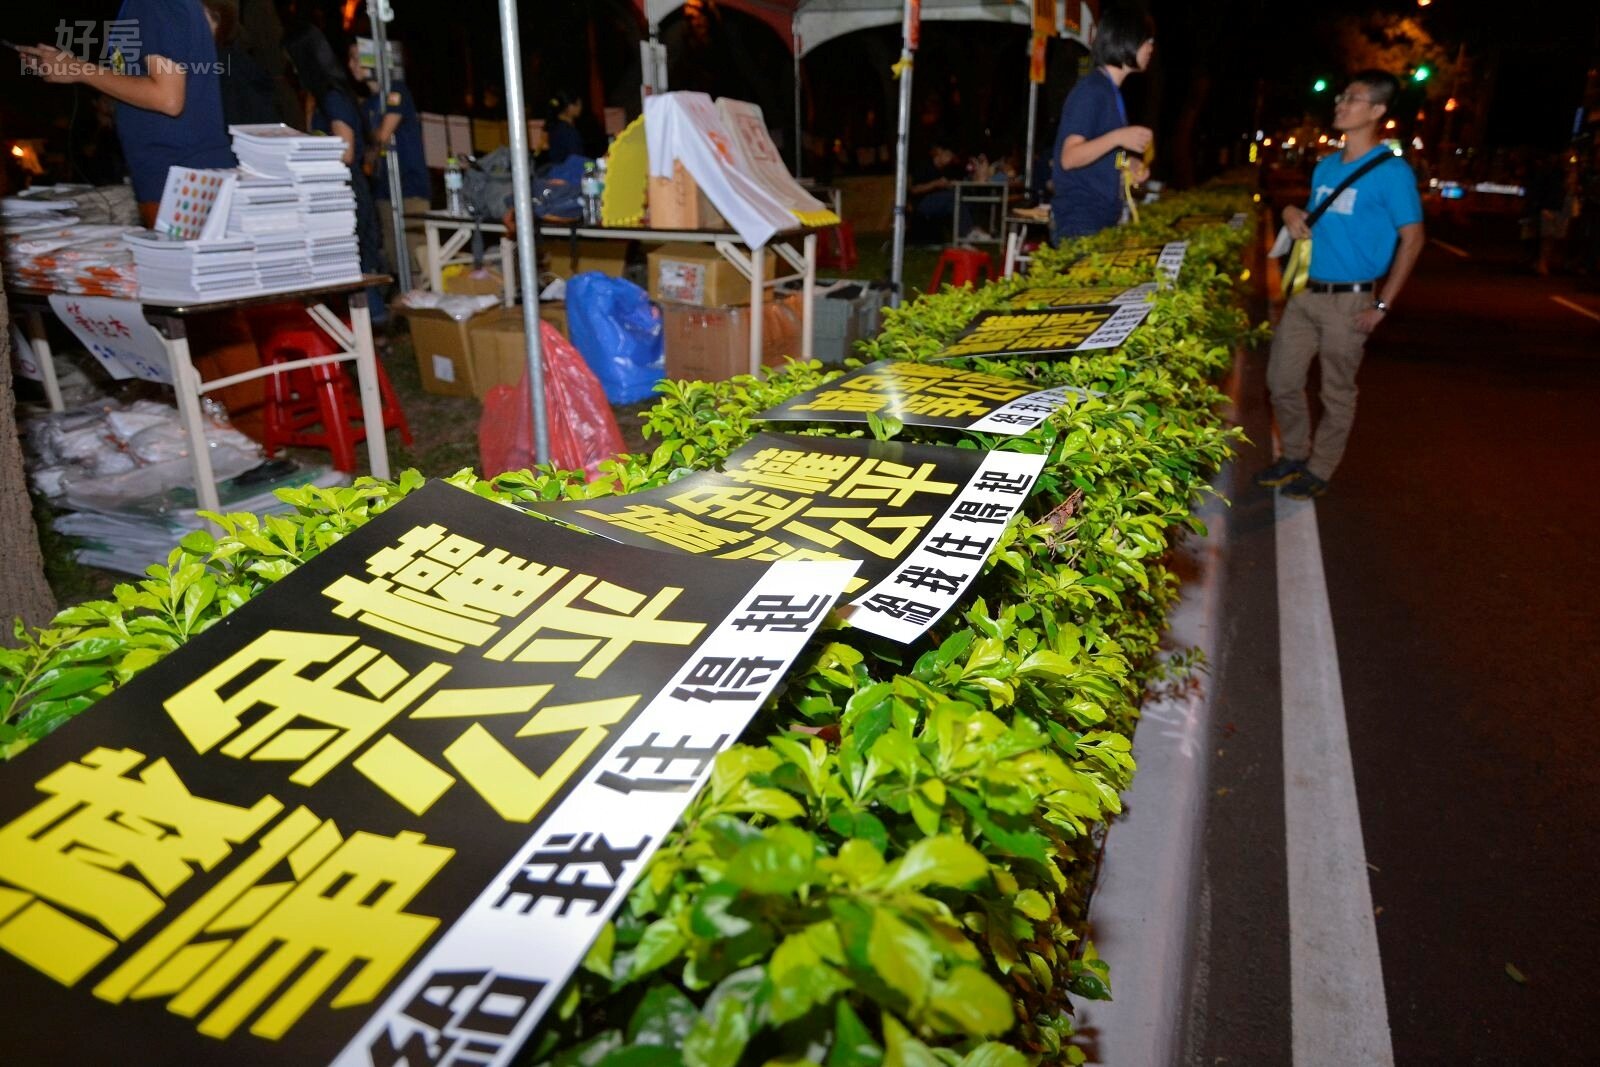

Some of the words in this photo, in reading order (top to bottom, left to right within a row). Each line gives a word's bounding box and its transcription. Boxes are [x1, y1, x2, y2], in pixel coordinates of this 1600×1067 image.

[862, 470, 1033, 626] 給我住得起
[91, 574, 707, 1041] 爭公平
[367, 593, 832, 1067] 給我住得起
